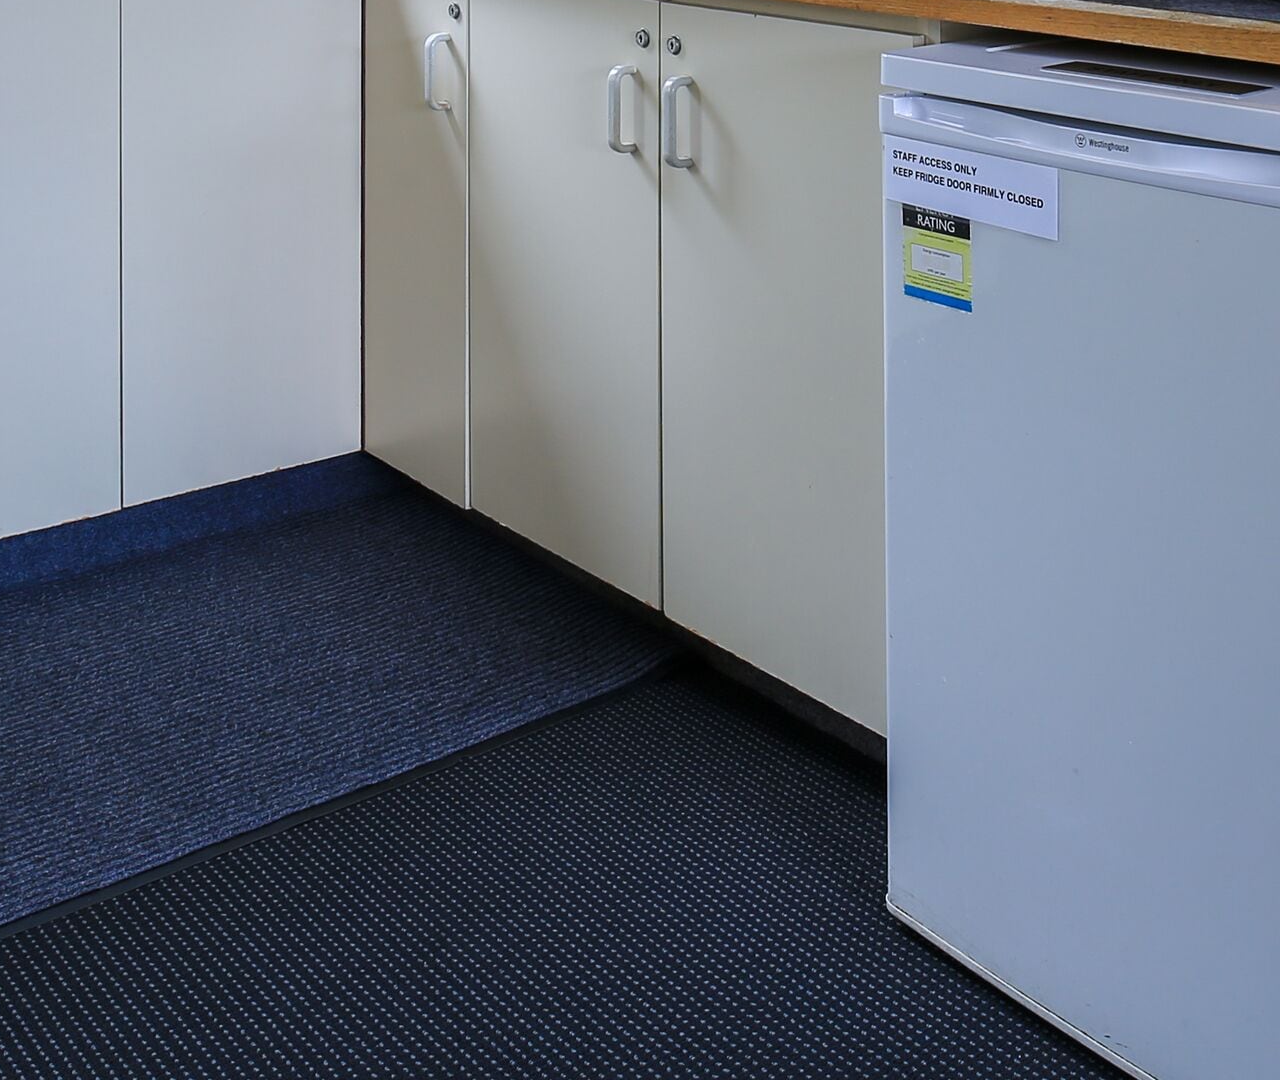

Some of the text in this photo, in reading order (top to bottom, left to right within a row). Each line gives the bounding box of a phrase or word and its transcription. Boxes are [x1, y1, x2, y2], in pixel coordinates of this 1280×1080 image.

[1089, 138, 1129, 153] Westinghouse
[892, 150, 977, 176] STAFF ACCESS ONLY
[892, 166, 1044, 209] KEEP FRIDGE DOOR FIRMLY CLOSED
[917, 213, 956, 233] RATING
